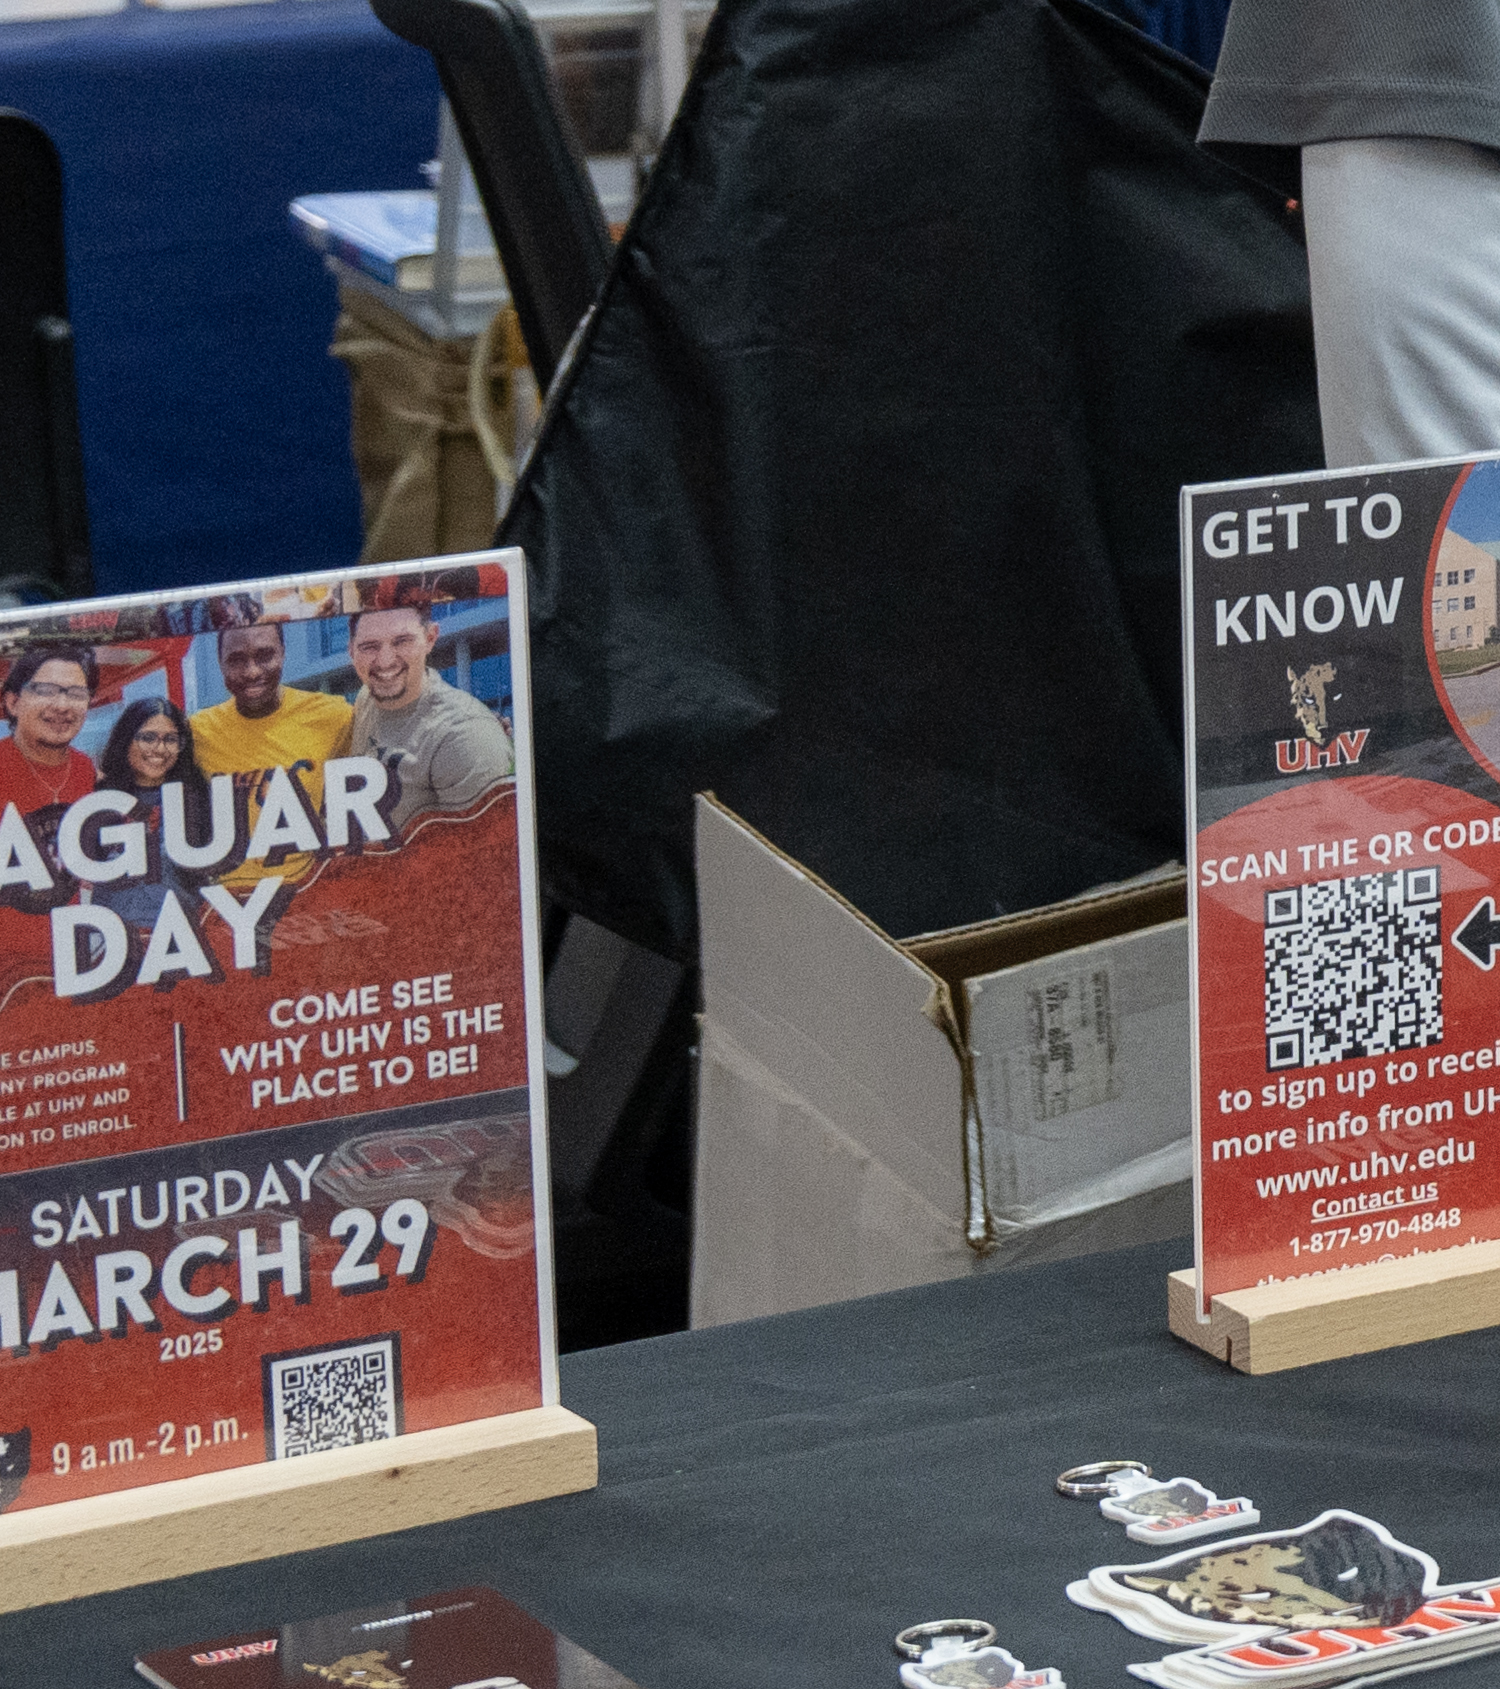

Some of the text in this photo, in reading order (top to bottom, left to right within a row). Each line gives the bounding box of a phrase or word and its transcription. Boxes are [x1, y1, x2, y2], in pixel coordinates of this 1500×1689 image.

[1202, 492, 1403, 559] GET TO
[1215, 577, 1404, 647] KNOW
[1275, 729, 1370, 773] UHV
[1201, 848, 1288, 888] SCAN
[1298, 837, 1359, 873] THE
[1368, 829, 1415, 865] QR
[50, 876, 285, 998] DAY
[268, 972, 455, 1030] COME SEE
[220, 1002, 506, 1076] WHY UHV IS THE
[33, 1062, 127, 1089] PROGRAM
[48, 1087, 131, 1116] UHV AND
[250, 1043, 480, 1109] PLACE TO BE!
[1218, 1088, 1253, 1114] to
[1261, 1074, 1326, 1110] sign
[1336, 1067, 1376, 1099] up
[1385, 1059, 1418, 1085] to
[30, 1115, 138, 1146] TO ENROLL.
[1212, 1126, 1298, 1162] more
[1306, 1110, 1369, 1146] info
[1378, 1098, 1454, 1132] from
[1256, 1137, 1477, 1199] www.uhv.edu
[31, 1154, 324, 1249] SATURDAY
[1311, 1181, 1439, 1220] Contact us
[330, 1197, 430, 1289] 29
[1289, 1207, 1462, 1257] 1-877-970-4848
[159, 1327, 224, 1362] 2025
[51, 1411, 249, 1476] 9 p.m.
